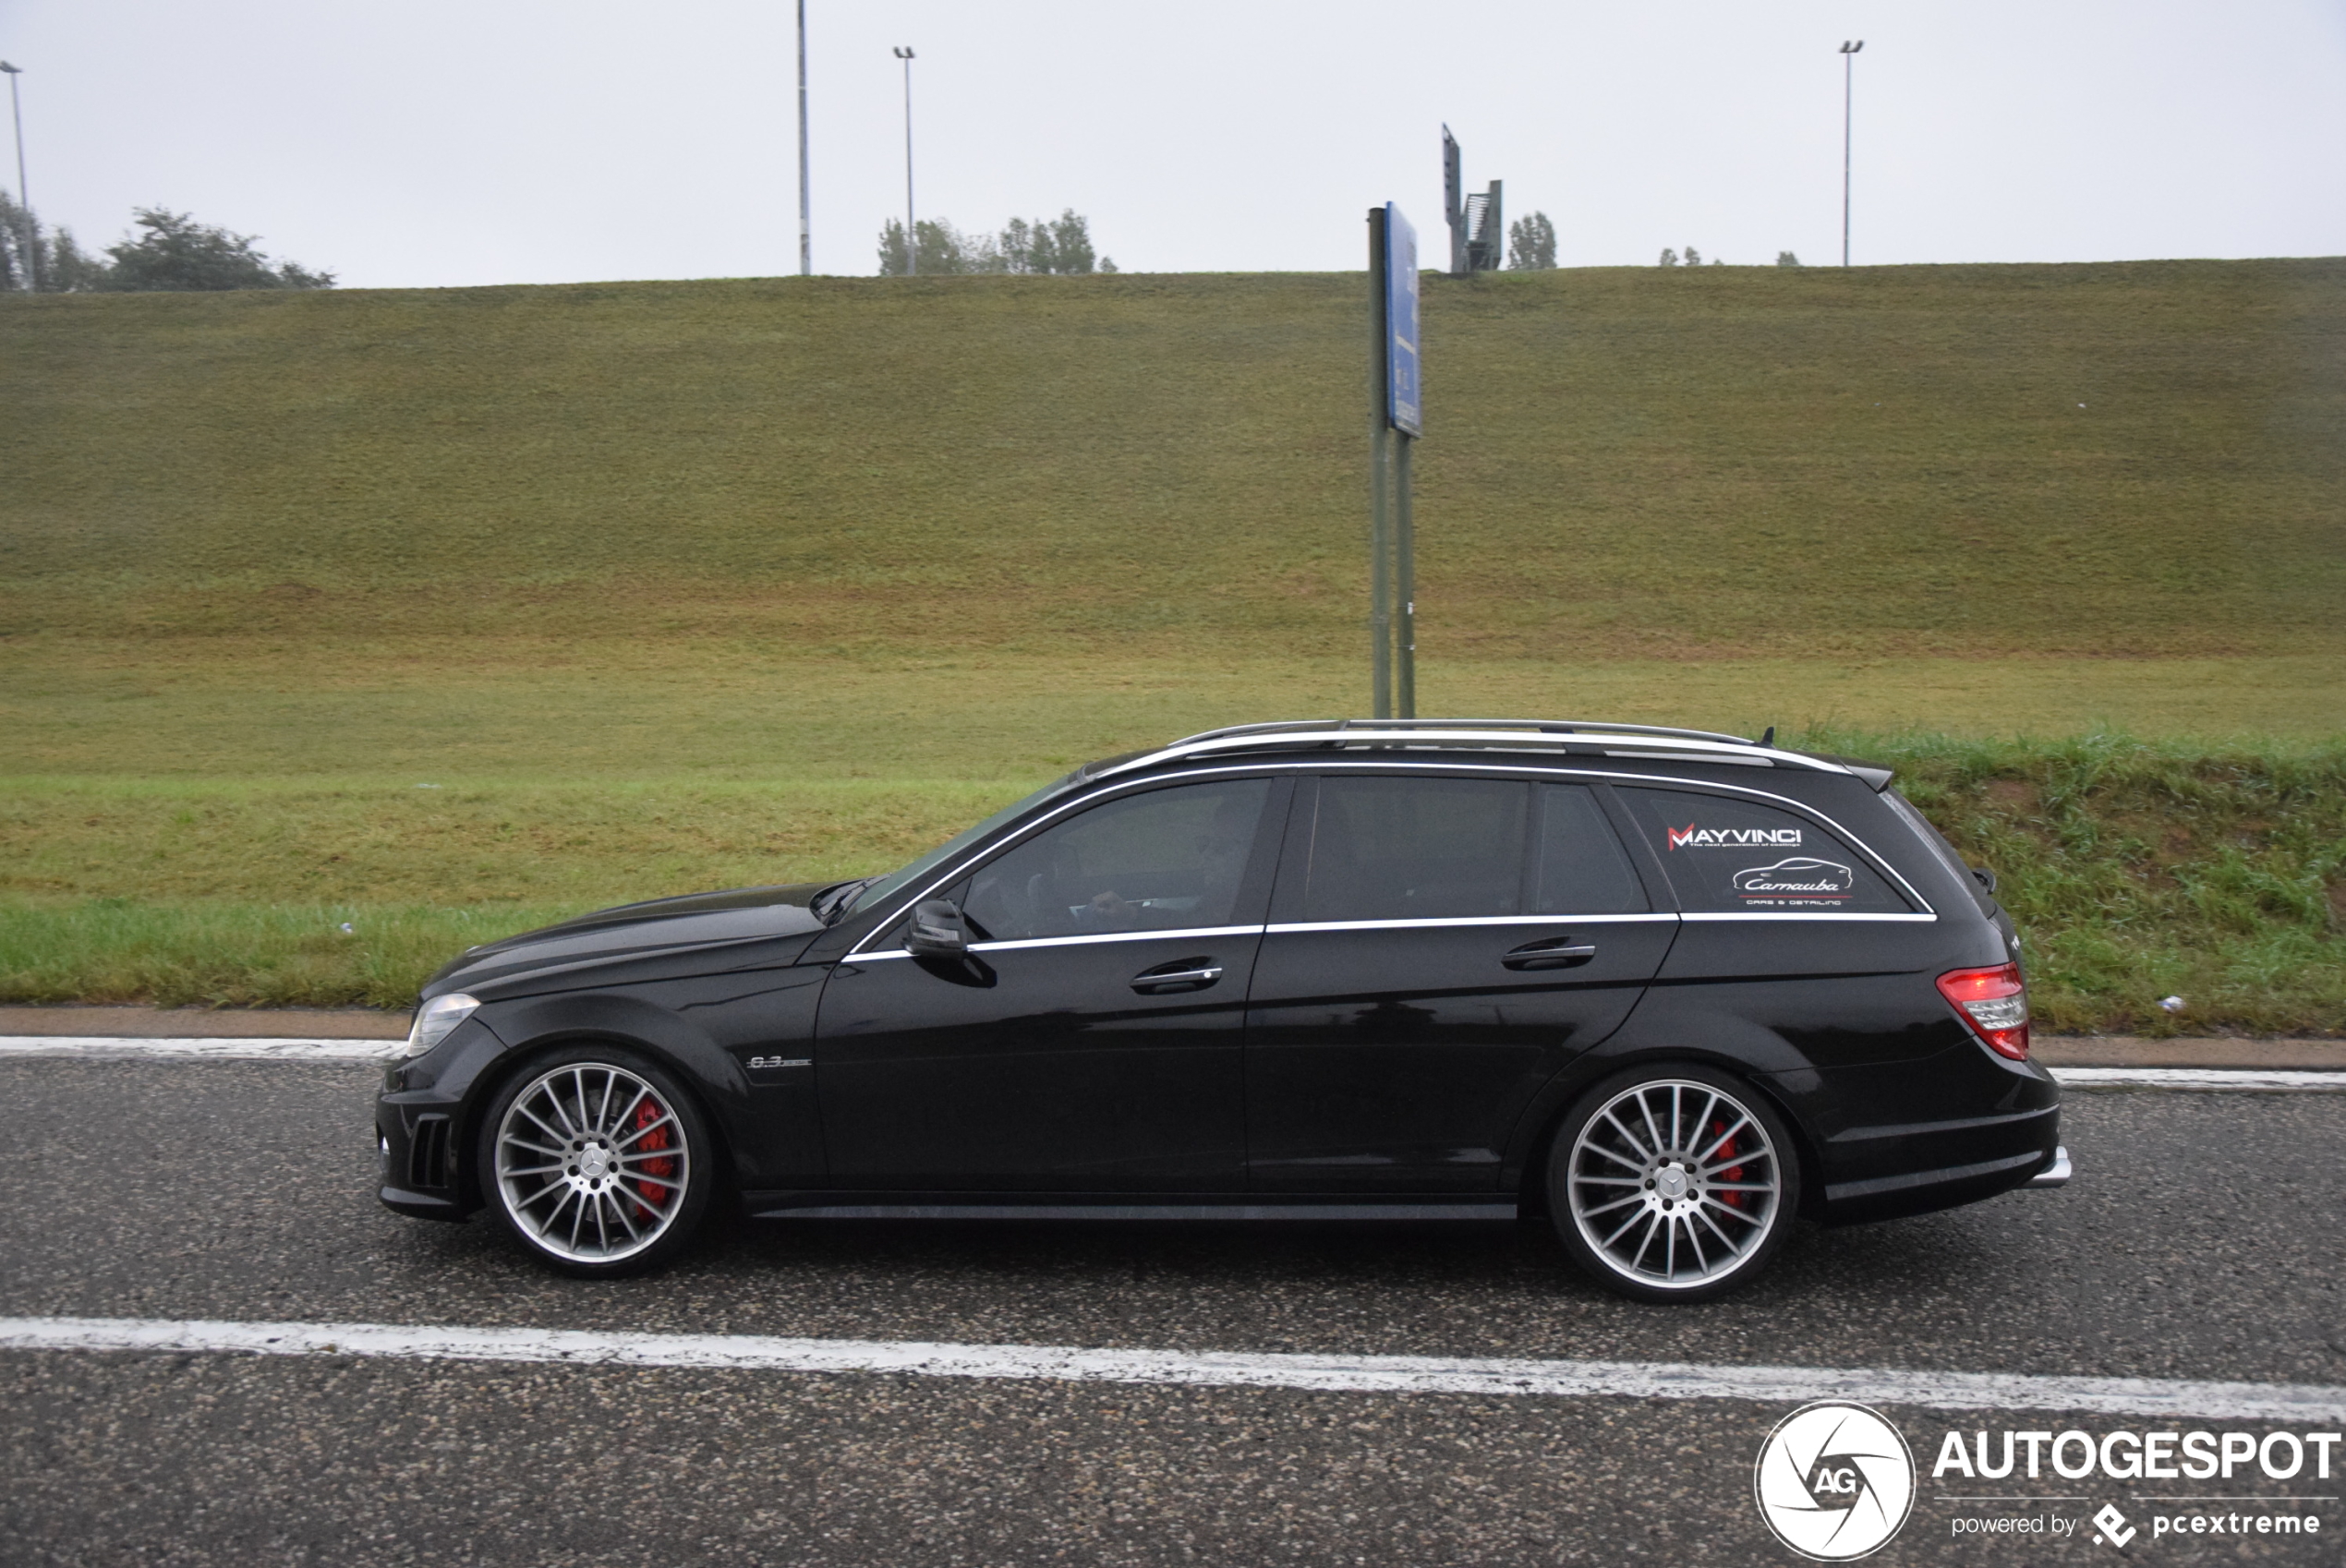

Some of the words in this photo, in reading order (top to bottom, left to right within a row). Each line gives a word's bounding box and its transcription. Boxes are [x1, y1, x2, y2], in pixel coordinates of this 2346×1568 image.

[1668, 823, 1801, 851] MAYVINCI
[1745, 878, 1840, 891] Carnauba
[750, 1055, 781, 1068] 6.3
